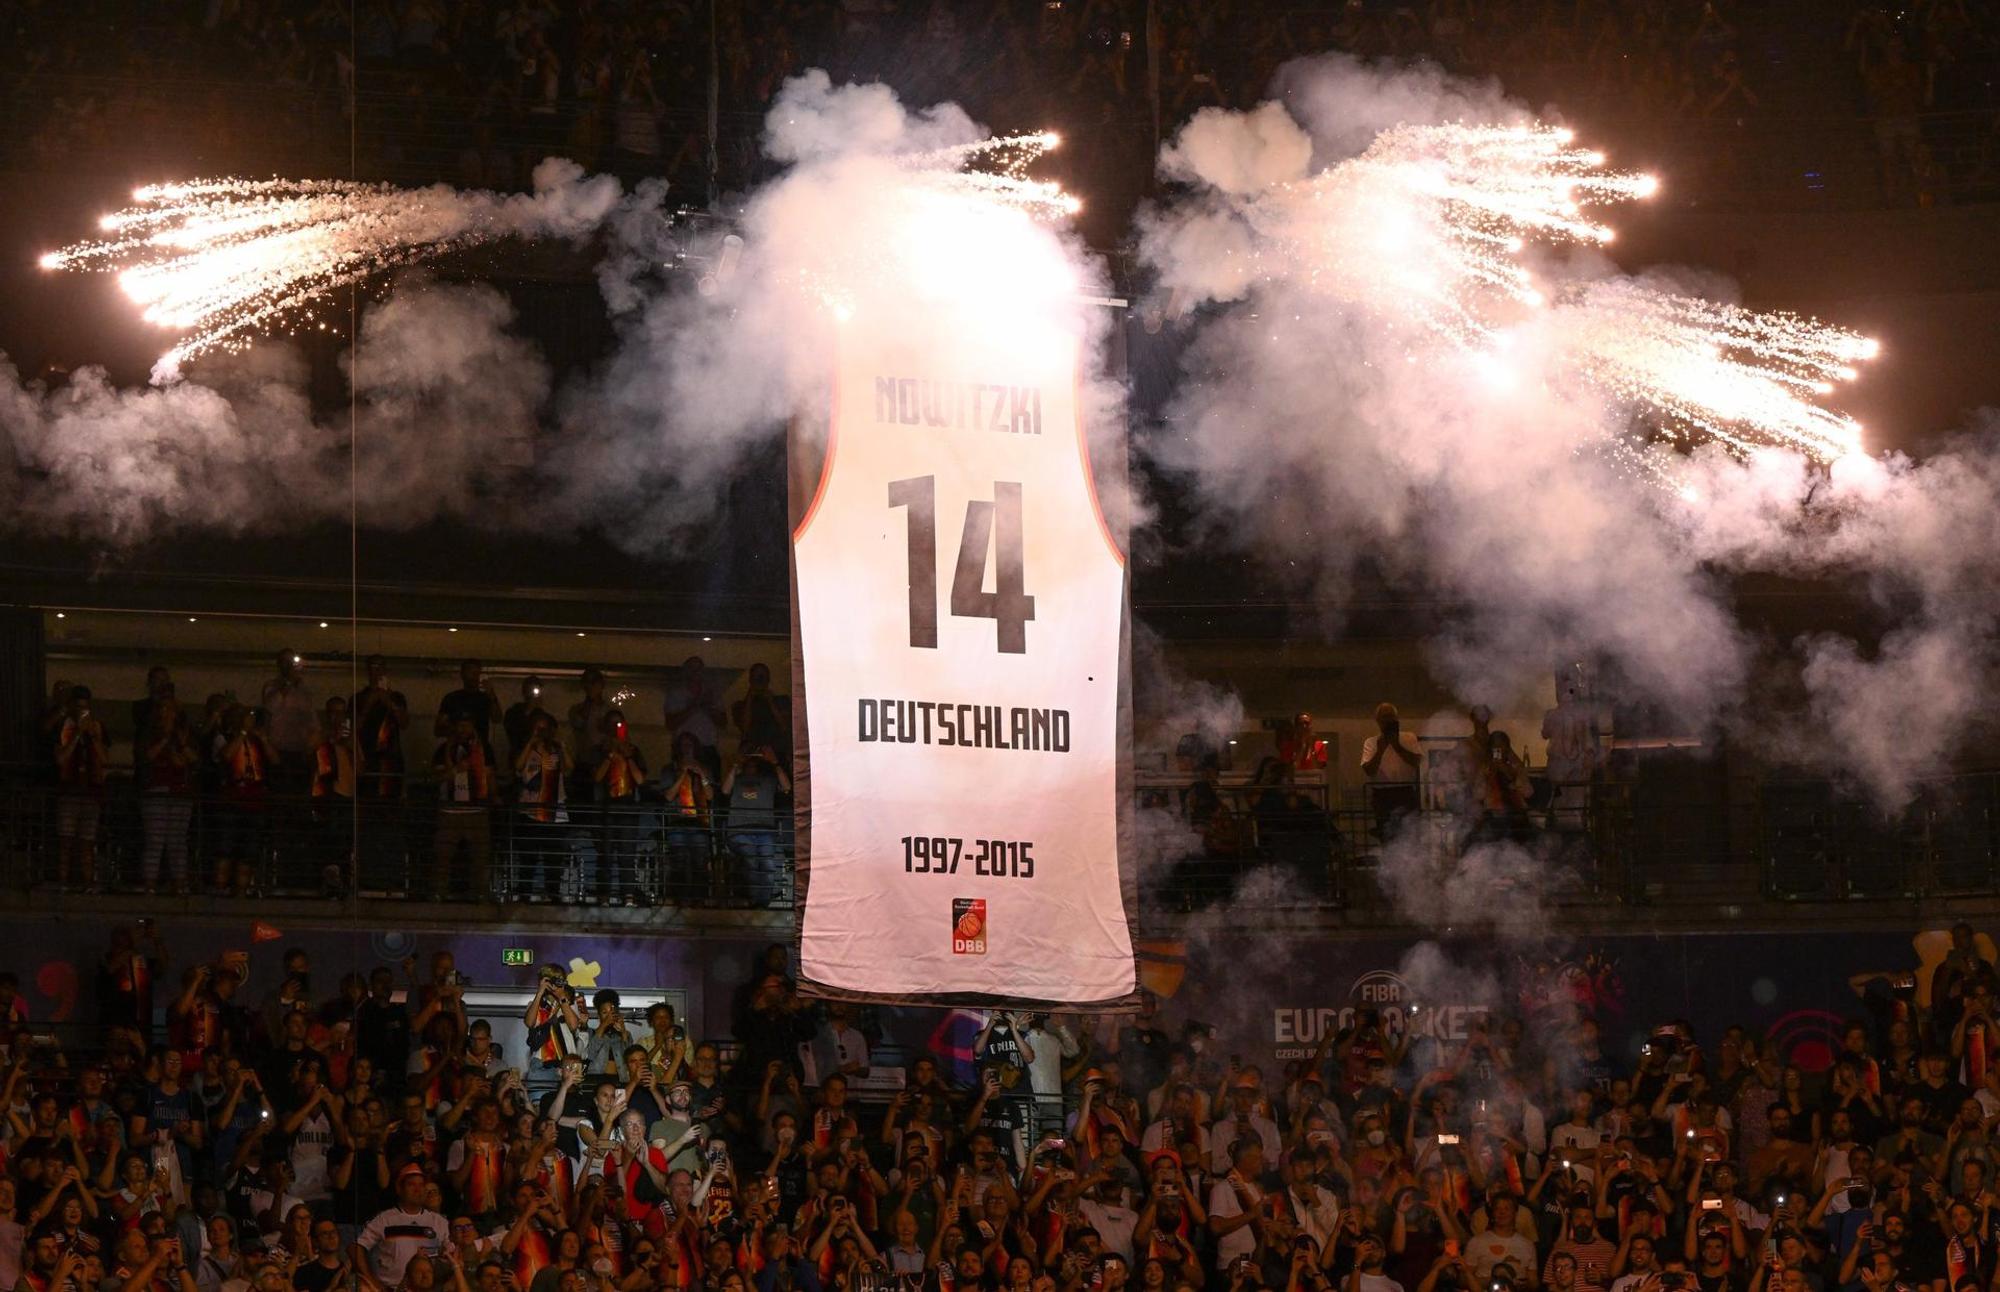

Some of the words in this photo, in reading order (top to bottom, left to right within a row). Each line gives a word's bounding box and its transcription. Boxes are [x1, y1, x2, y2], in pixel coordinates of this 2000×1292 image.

[875, 376, 1041, 434] NOWITZKI
[888, 475, 1035, 654] 14
[858, 698, 1070, 752] DEUTSCHLAND
[901, 836, 1034, 878] 1997-2015
[955, 939, 985, 952] DBB
[1362, 985, 1400, 1001] FIBA
